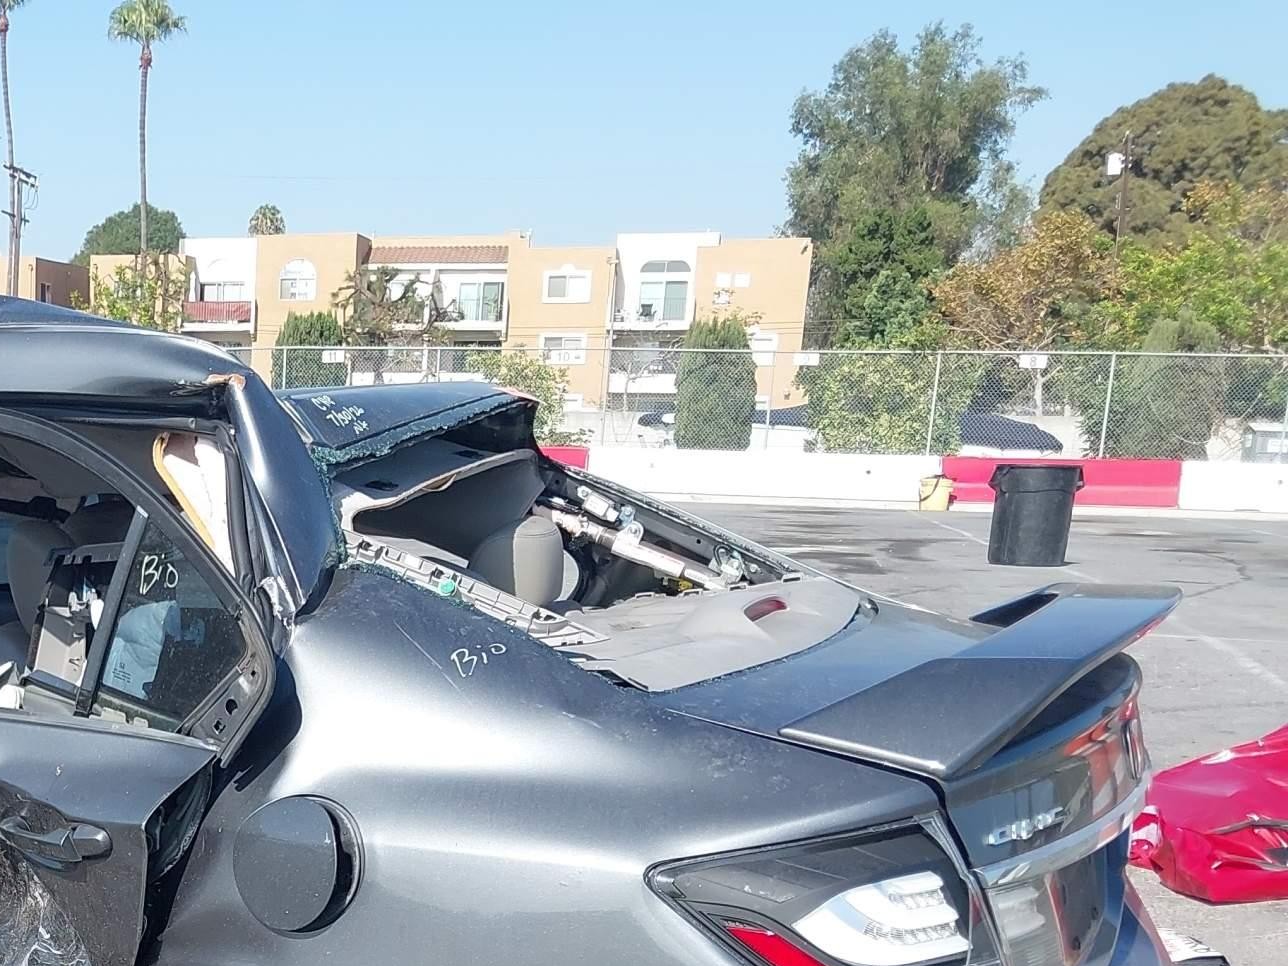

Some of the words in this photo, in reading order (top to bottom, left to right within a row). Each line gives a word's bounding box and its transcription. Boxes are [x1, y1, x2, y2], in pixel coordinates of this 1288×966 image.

[1029, 355, 1038, 367] 8
[139, 553, 179, 595] Bio
[450, 643, 507, 678] Bio
